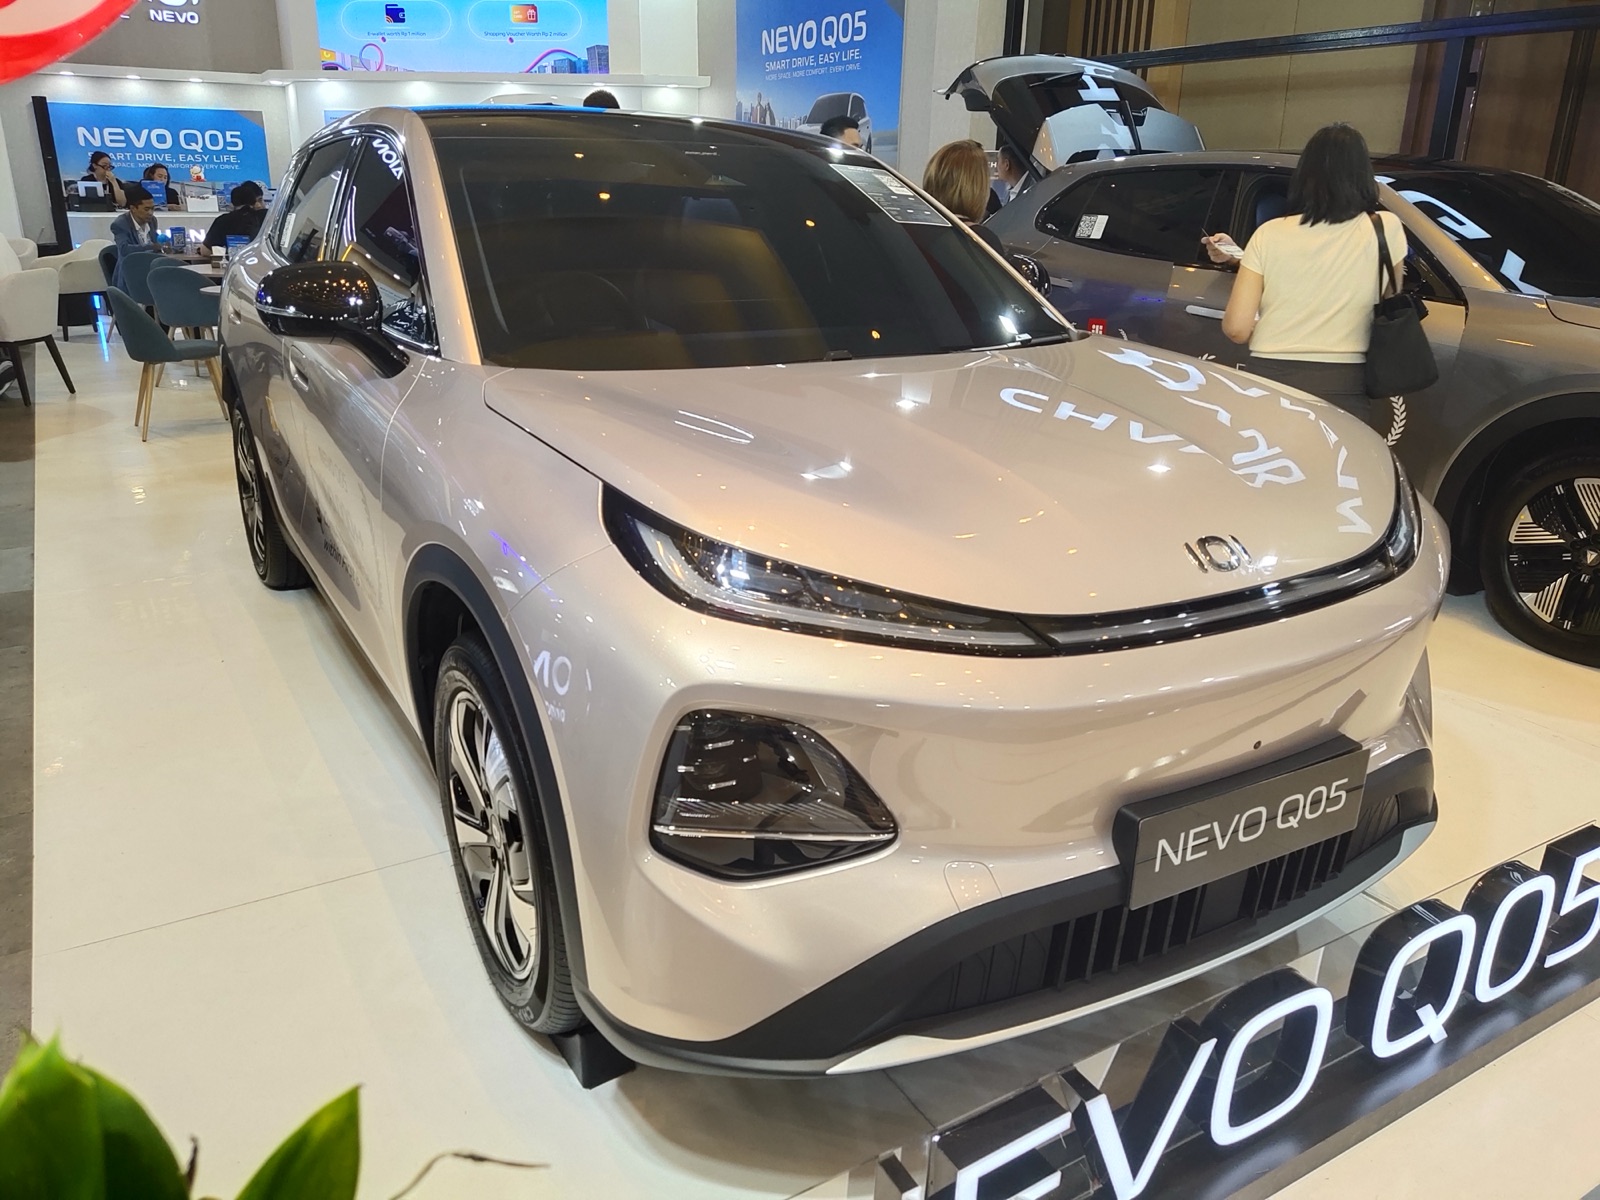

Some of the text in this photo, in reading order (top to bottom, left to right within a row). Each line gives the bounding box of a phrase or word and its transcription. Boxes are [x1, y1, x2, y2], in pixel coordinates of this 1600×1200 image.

[149, 9, 199, 24] NEVO
[761, 9, 867, 56] NEVO Q05
[765, 48, 862, 72] SMART DRIVE, EASY LIFE.
[77, 126, 243, 152] NEVO Q05
[87, 151, 241, 163] SART DRIVE, EASY LIFE.
[1154, 777, 1349, 873] NEVO Q05
[902, 846, 1600, 1200] EVO Q05
